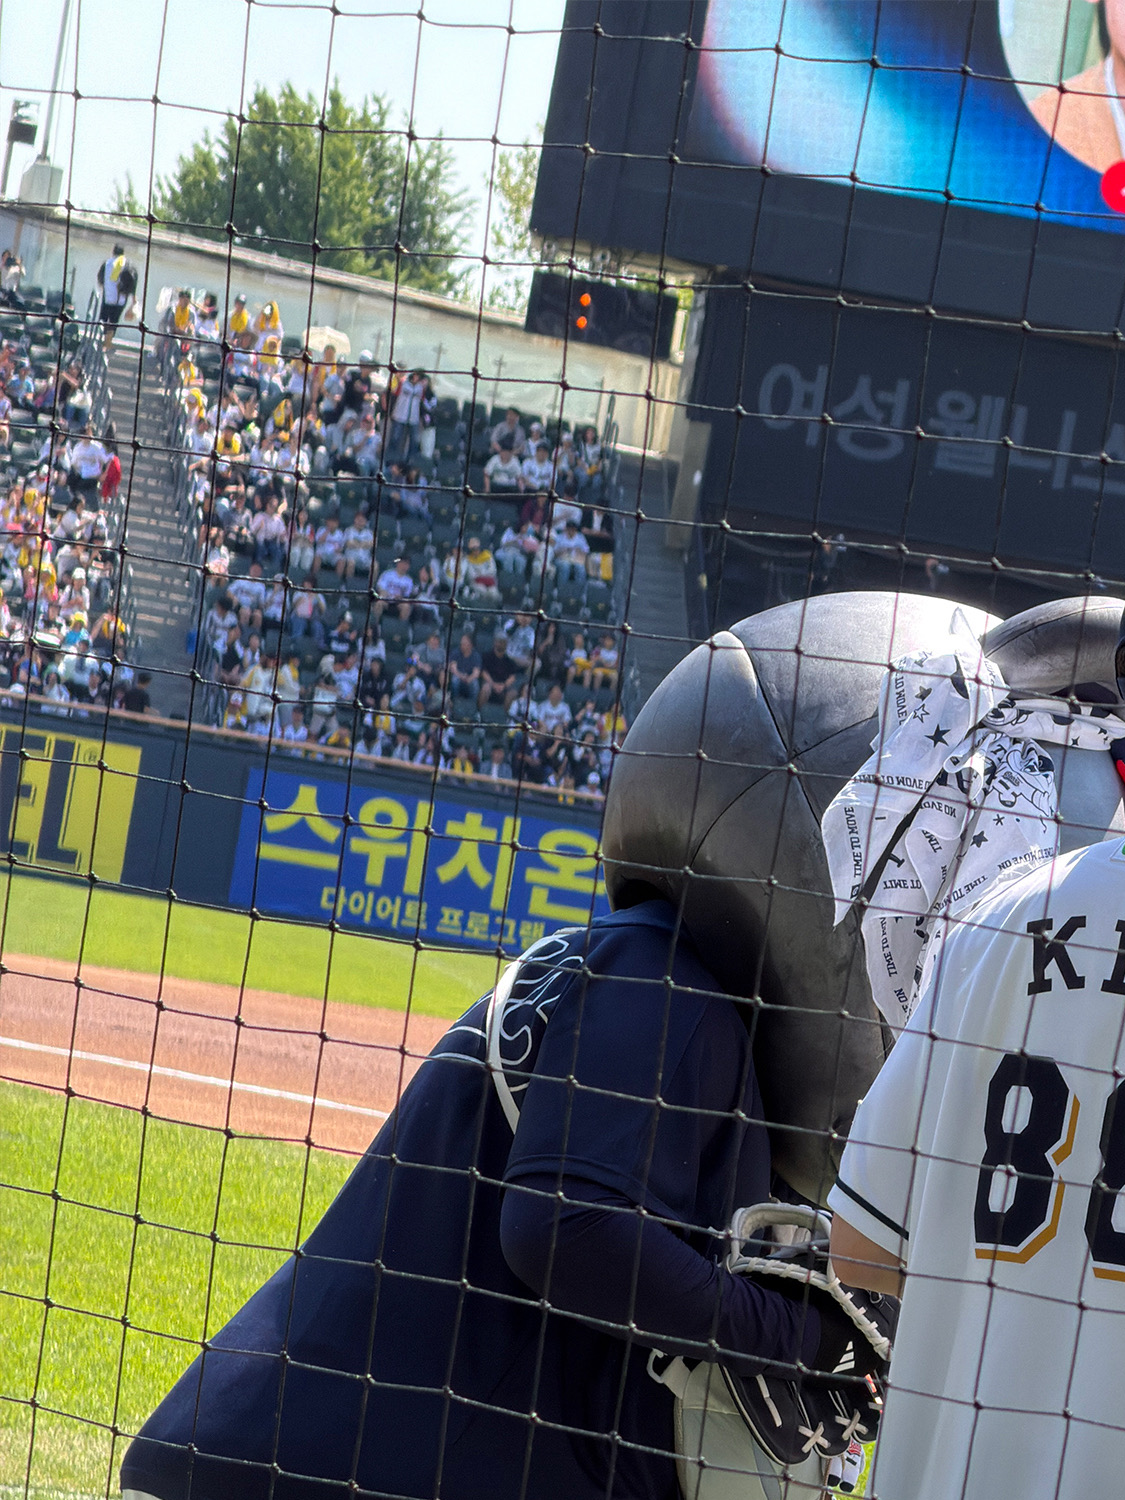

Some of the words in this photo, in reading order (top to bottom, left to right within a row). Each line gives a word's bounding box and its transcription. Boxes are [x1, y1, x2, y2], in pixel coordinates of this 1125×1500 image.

[758, 363, 911, 462] 여성
[844, 806, 859, 836] MOVE
[257, 784, 607, 924] 스위치온
[850, 837, 862, 850] TO
[853, 852, 862, 877] TIME
[964, 875, 988, 894] TIME
[320, 886, 428, 930] 다이어트
[436, 906, 546, 950] 프로그램
[881, 936, 890, 952] TO
[883, 951, 898, 977] TIME
